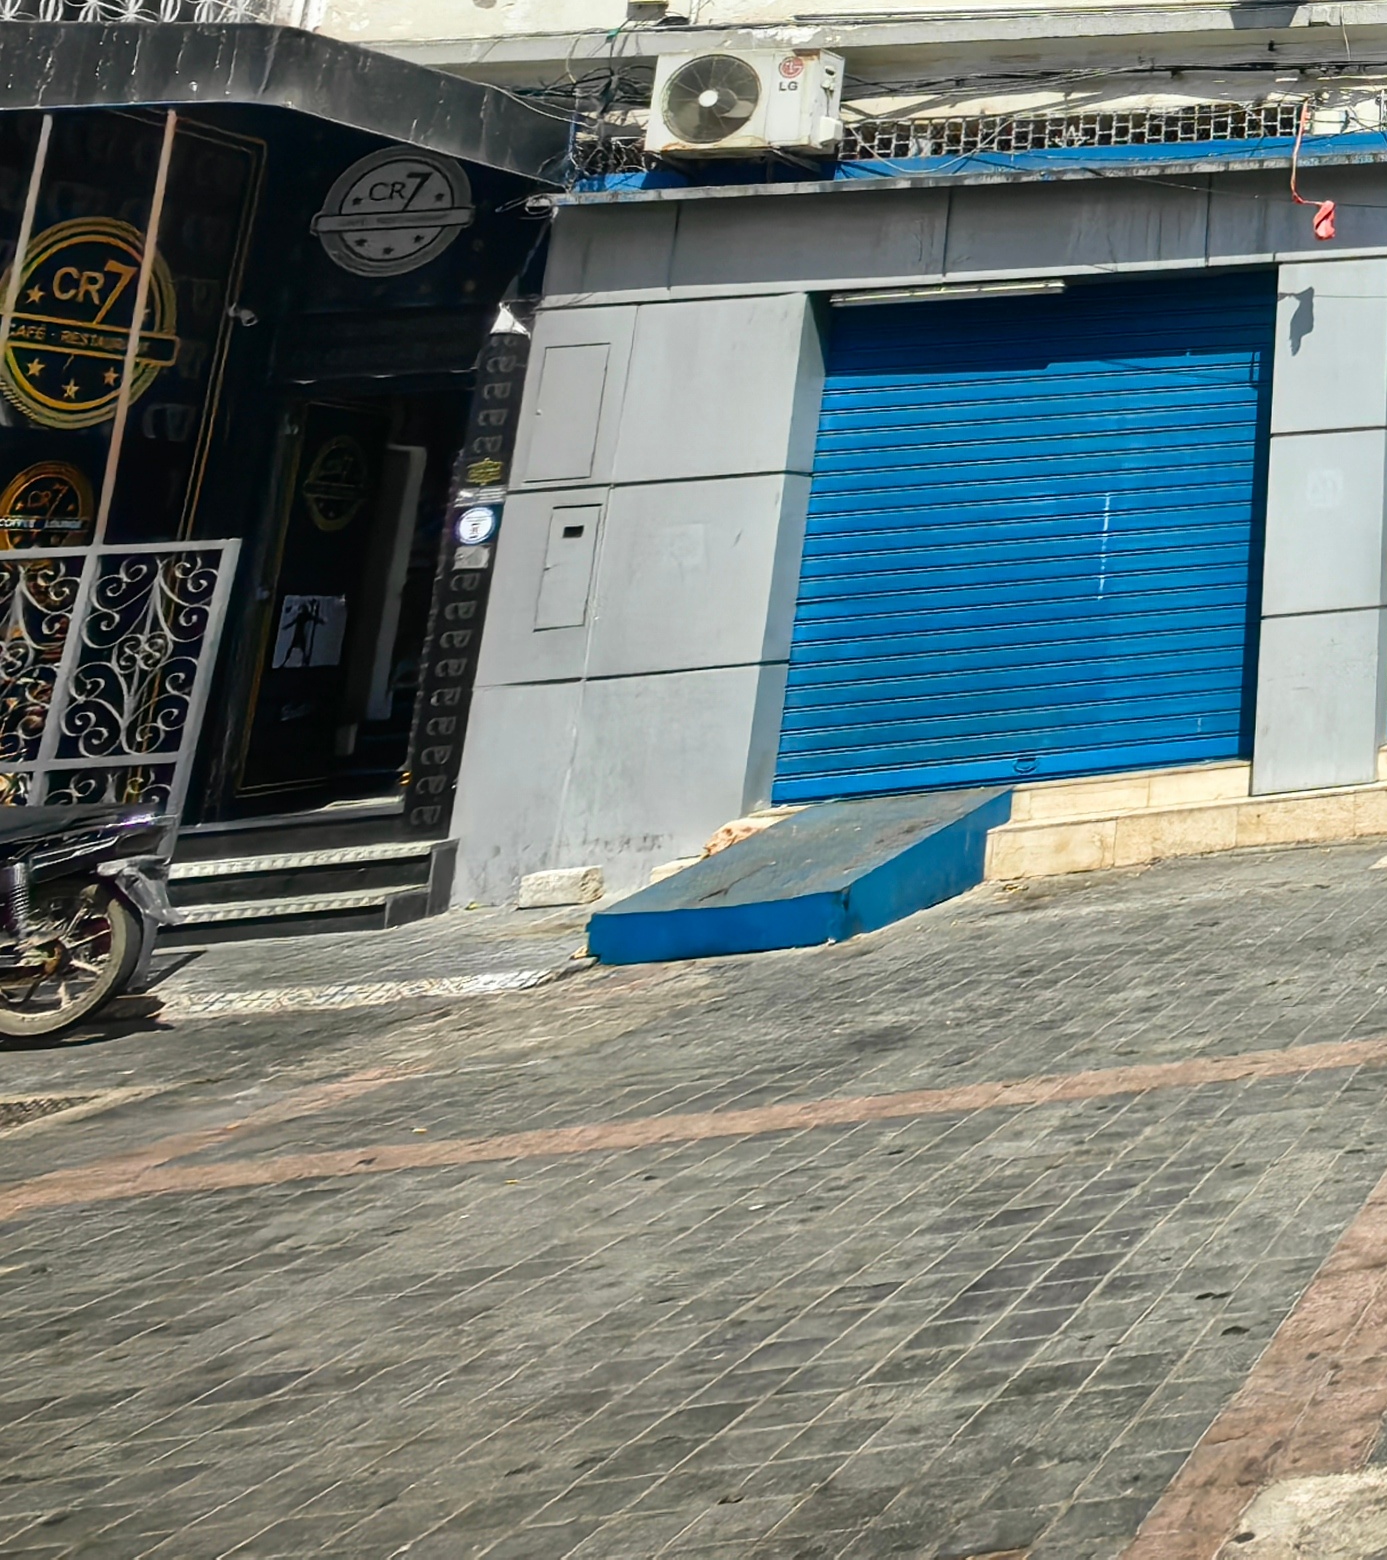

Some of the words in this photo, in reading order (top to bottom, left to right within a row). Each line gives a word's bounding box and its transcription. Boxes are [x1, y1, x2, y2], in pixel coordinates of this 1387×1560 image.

[778, 80, 799, 92] LG
[368, 171, 434, 211] CR7
[52, 259, 139, 324] CR7
